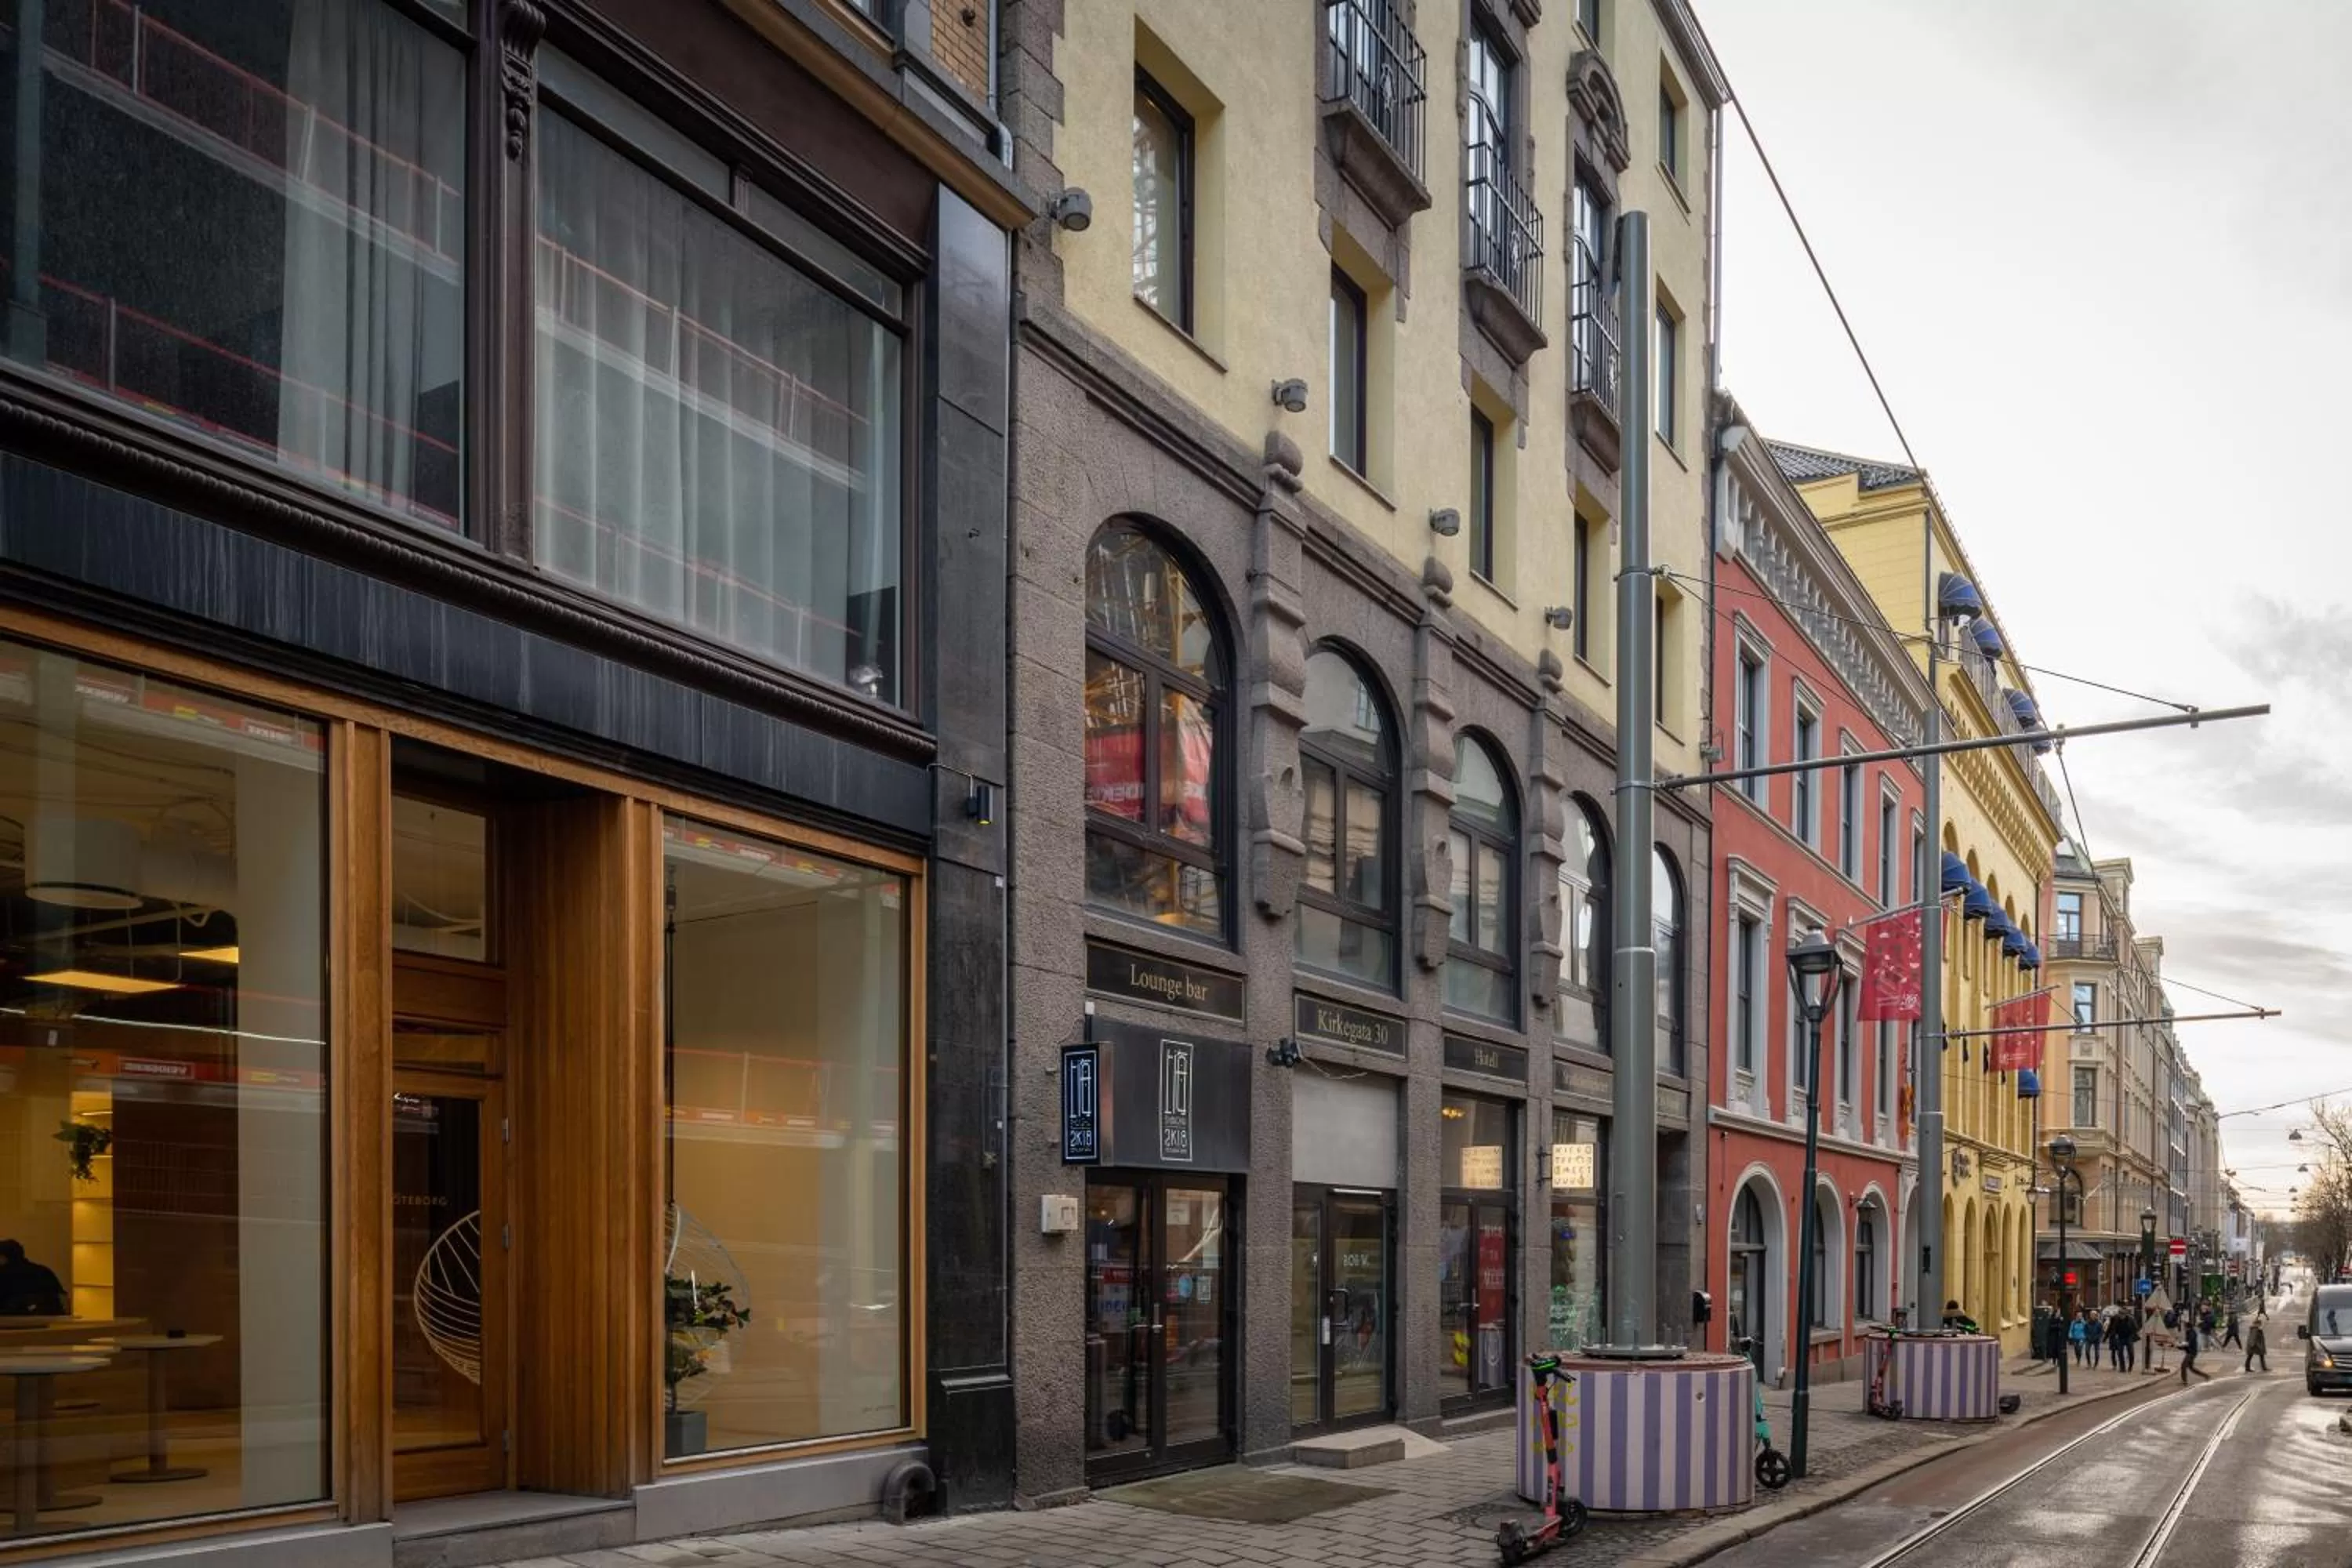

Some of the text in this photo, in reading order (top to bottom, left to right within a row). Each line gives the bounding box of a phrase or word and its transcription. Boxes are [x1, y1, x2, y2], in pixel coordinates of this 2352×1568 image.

[1131, 964, 1209, 1001] Lounge bar
[1318, 1009, 1388, 1044] Kirkegata 30
[1070, 1130, 1092, 1147] 2K18
[1164, 1128, 1188, 1148] 2K18
[392, 1192, 448, 1206] ÖTEBORG
